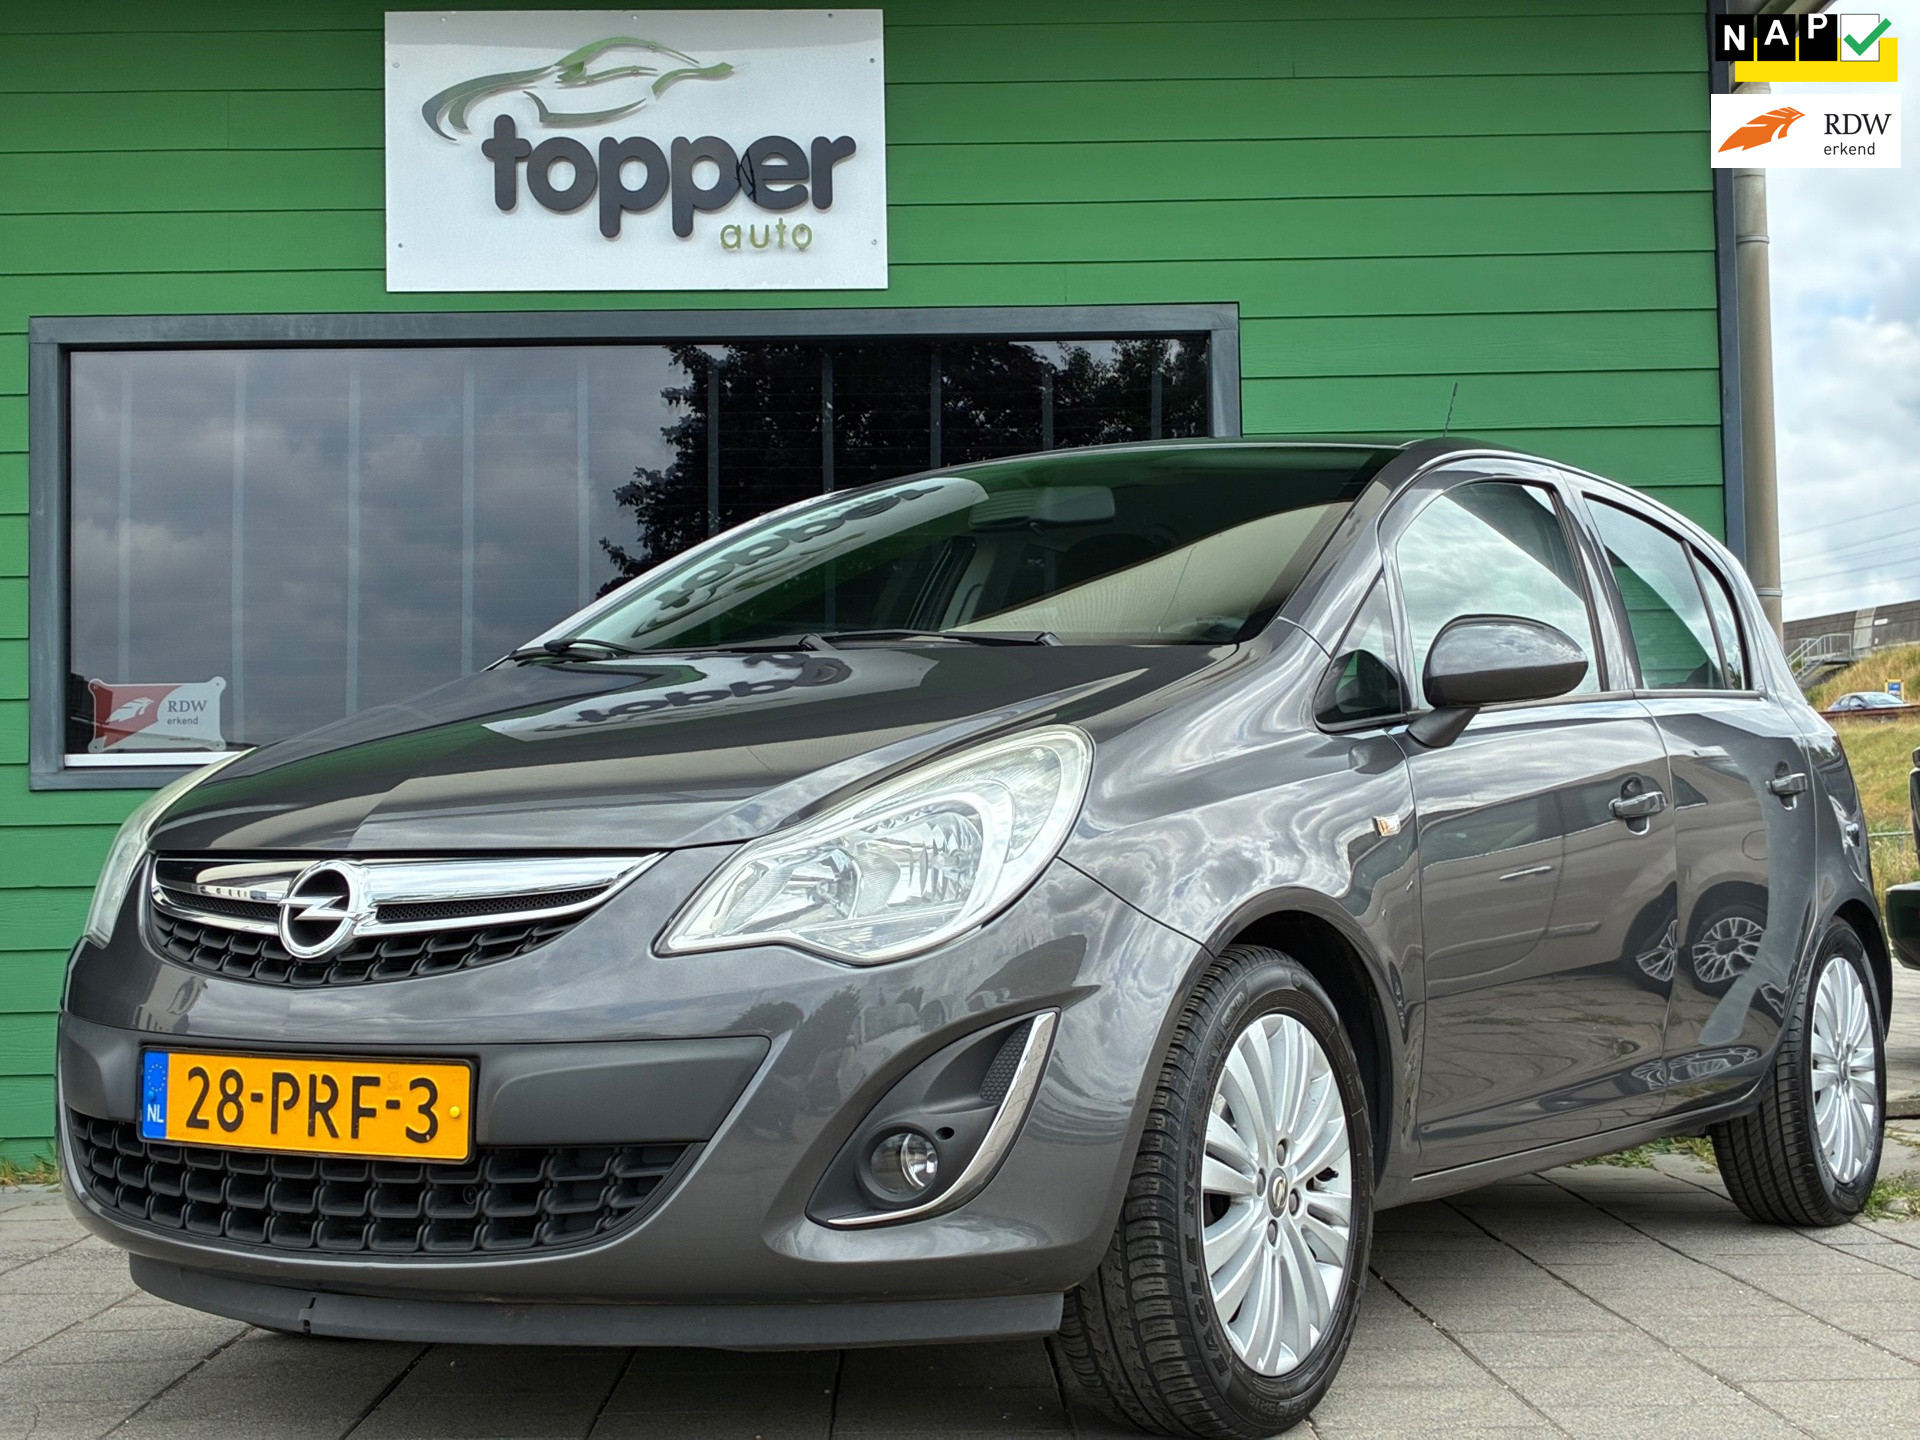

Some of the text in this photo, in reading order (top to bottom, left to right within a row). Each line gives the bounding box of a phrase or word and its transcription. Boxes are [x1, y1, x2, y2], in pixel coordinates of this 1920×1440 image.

[481, 114, 857, 238] topper
[720, 218, 813, 251] auto
[167, 700, 207, 713] RDW
[167, 716, 199, 725] erkend
[146, 1066, 439, 1144] NL 28-PRF-3
[1184, 1233, 1230, 1377] EAGLE
